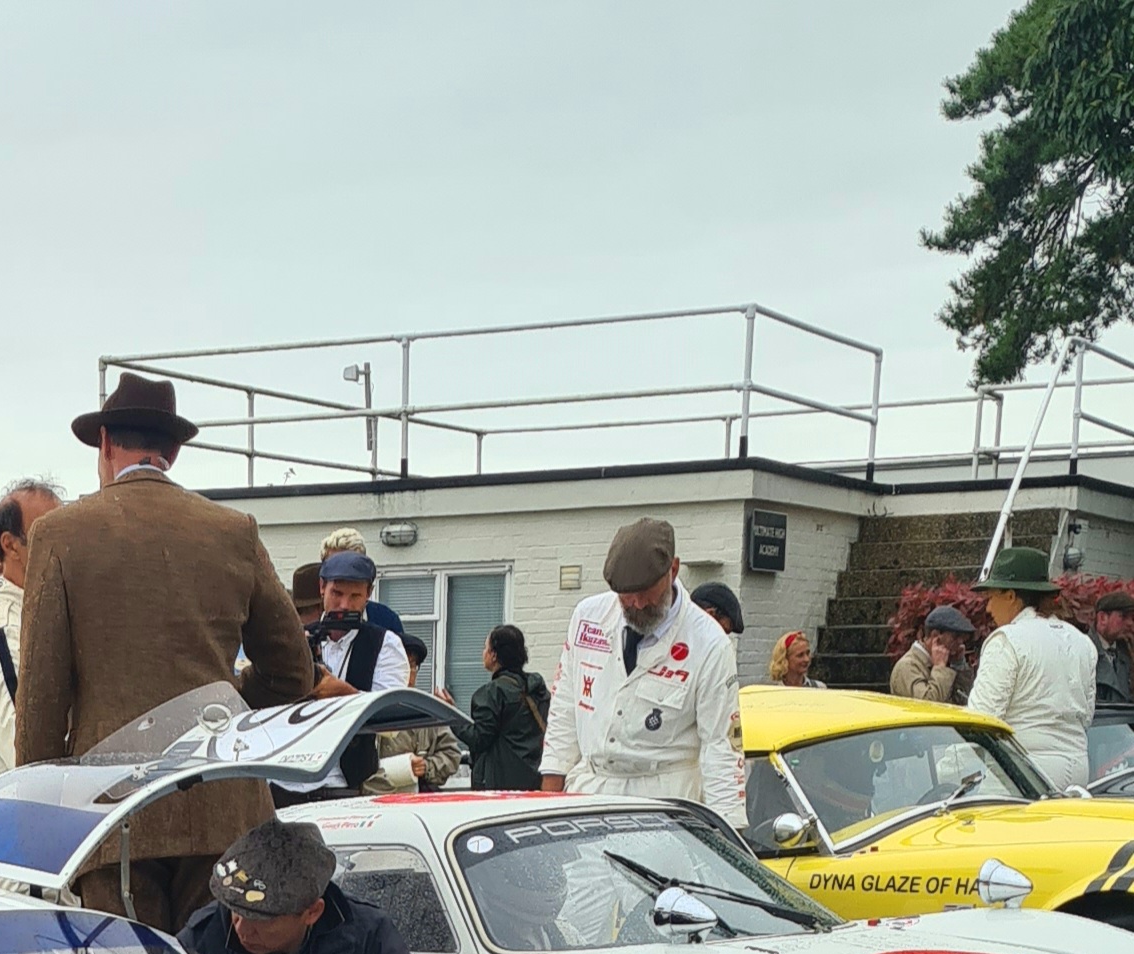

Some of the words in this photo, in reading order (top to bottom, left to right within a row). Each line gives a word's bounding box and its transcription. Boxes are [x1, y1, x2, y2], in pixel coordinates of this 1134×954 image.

[754, 525, 775, 538] ULTIMATE
[759, 544, 780, 557] ACADEMY
[809, 873, 856, 891] DYNA
[861, 875, 922, 893] GLAZE
[926, 877, 952, 894] OF
[955, 878, 981, 895] HA
